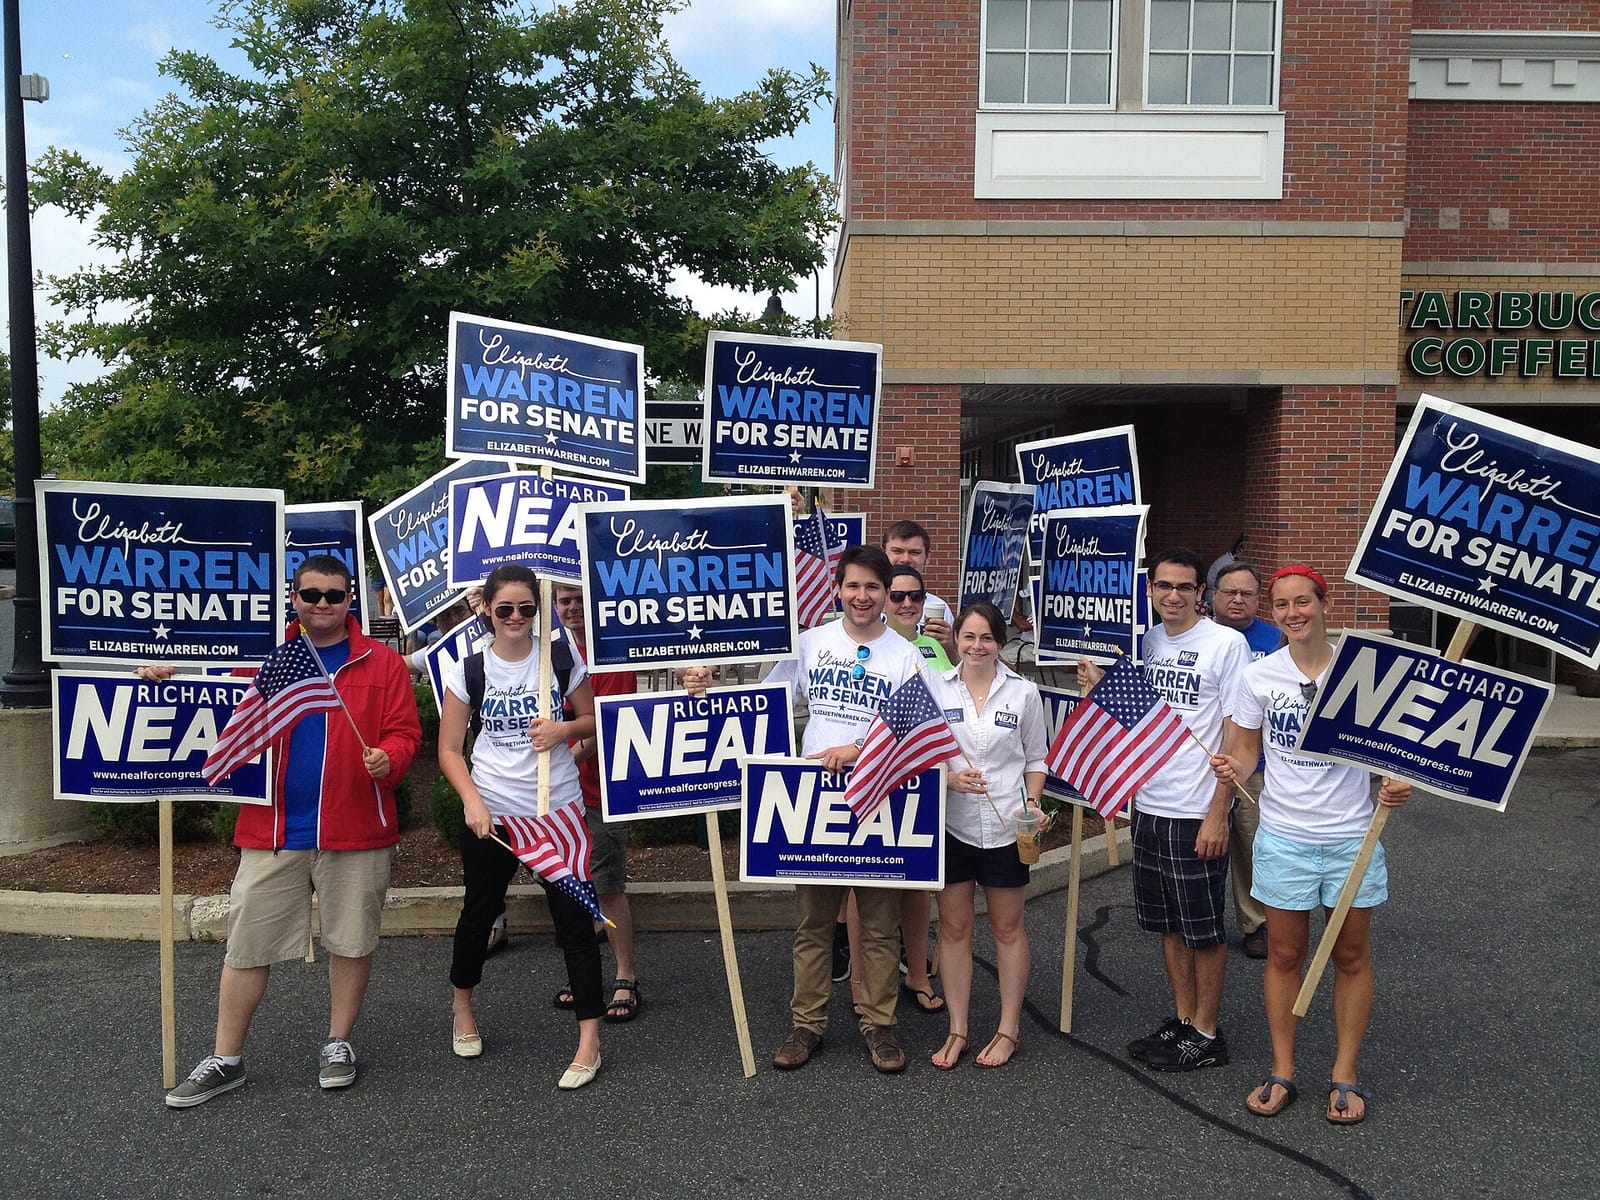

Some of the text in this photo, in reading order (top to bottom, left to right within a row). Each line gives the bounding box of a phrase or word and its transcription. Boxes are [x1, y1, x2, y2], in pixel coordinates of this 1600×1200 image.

[479, 328, 621, 384] Elizabeth
[734, 346, 861, 401] Elizabeth
[1410, 336, 1600, 377] COFFE
[462, 363, 634, 420] WARREN
[718, 384, 872, 426] WARREN
[461, 398, 635, 445] FOR SENATE
[716, 420, 768, 447] FOR
[773, 423, 869, 452] SENATE
[487, 441, 611, 468] ELIZABETHWARREN.COM
[738, 464, 846, 478] ELIZABETHWARREN.COM
[1031, 452, 1121, 492] Elizabeth
[1440, 422, 1600, 519] Elizabeth
[519, 479, 609, 502] RICHARD
[1035, 472, 1132, 511] WARREN
[72, 497, 253, 561] Elizabeth
[389, 493, 448, 540] Elizabet
[458, 481, 581, 553] NEA
[1030, 513, 1047, 534] FO
[1381, 508, 1461, 560] FOR
[1405, 463, 1600, 572] WARRE
[387, 516, 449, 573] WAR
[610, 516, 767, 571] Elizabeth
[1055, 522, 1127, 572] Elizabeth
[55, 544, 270, 590] WARREN
[396, 558, 440, 598] FOR
[595, 552, 784, 597] WARREN
[964, 570, 988, 595] FOR
[1047, 559, 1133, 595] WARREN
[57, 587, 271, 622] FOR SENATE
[598, 591, 785, 627] FOR SENATE
[1044, 594, 1132, 624] FOR SENATE
[1398, 572, 1560, 634] ELIZABETHWARREN.COM
[89, 640, 239, 656] ELIZABETHWARREN.COM
[629, 640, 760, 658] ELIZABETHWARREN.COM
[1056, 637, 1119, 654] ELIZABETHWARREN.COM
[808, 686, 829, 701] FOR
[1413, 660, 1525, 705] RICHARD
[66, 683, 262, 765] NEA
[673, 695, 769, 719] RICHARD
[1319, 646, 1517, 768] NEAL
[611, 703, 785, 782] NEAL
[1269, 730, 1297, 749] FOR
[1338, 731, 1474, 779] www.nealforcongress.com
[639, 778, 742, 797] www.nealforcongress.
[752, 770, 935, 848] NEAL
[778, 852, 905, 865] www.nealforcongress.com
